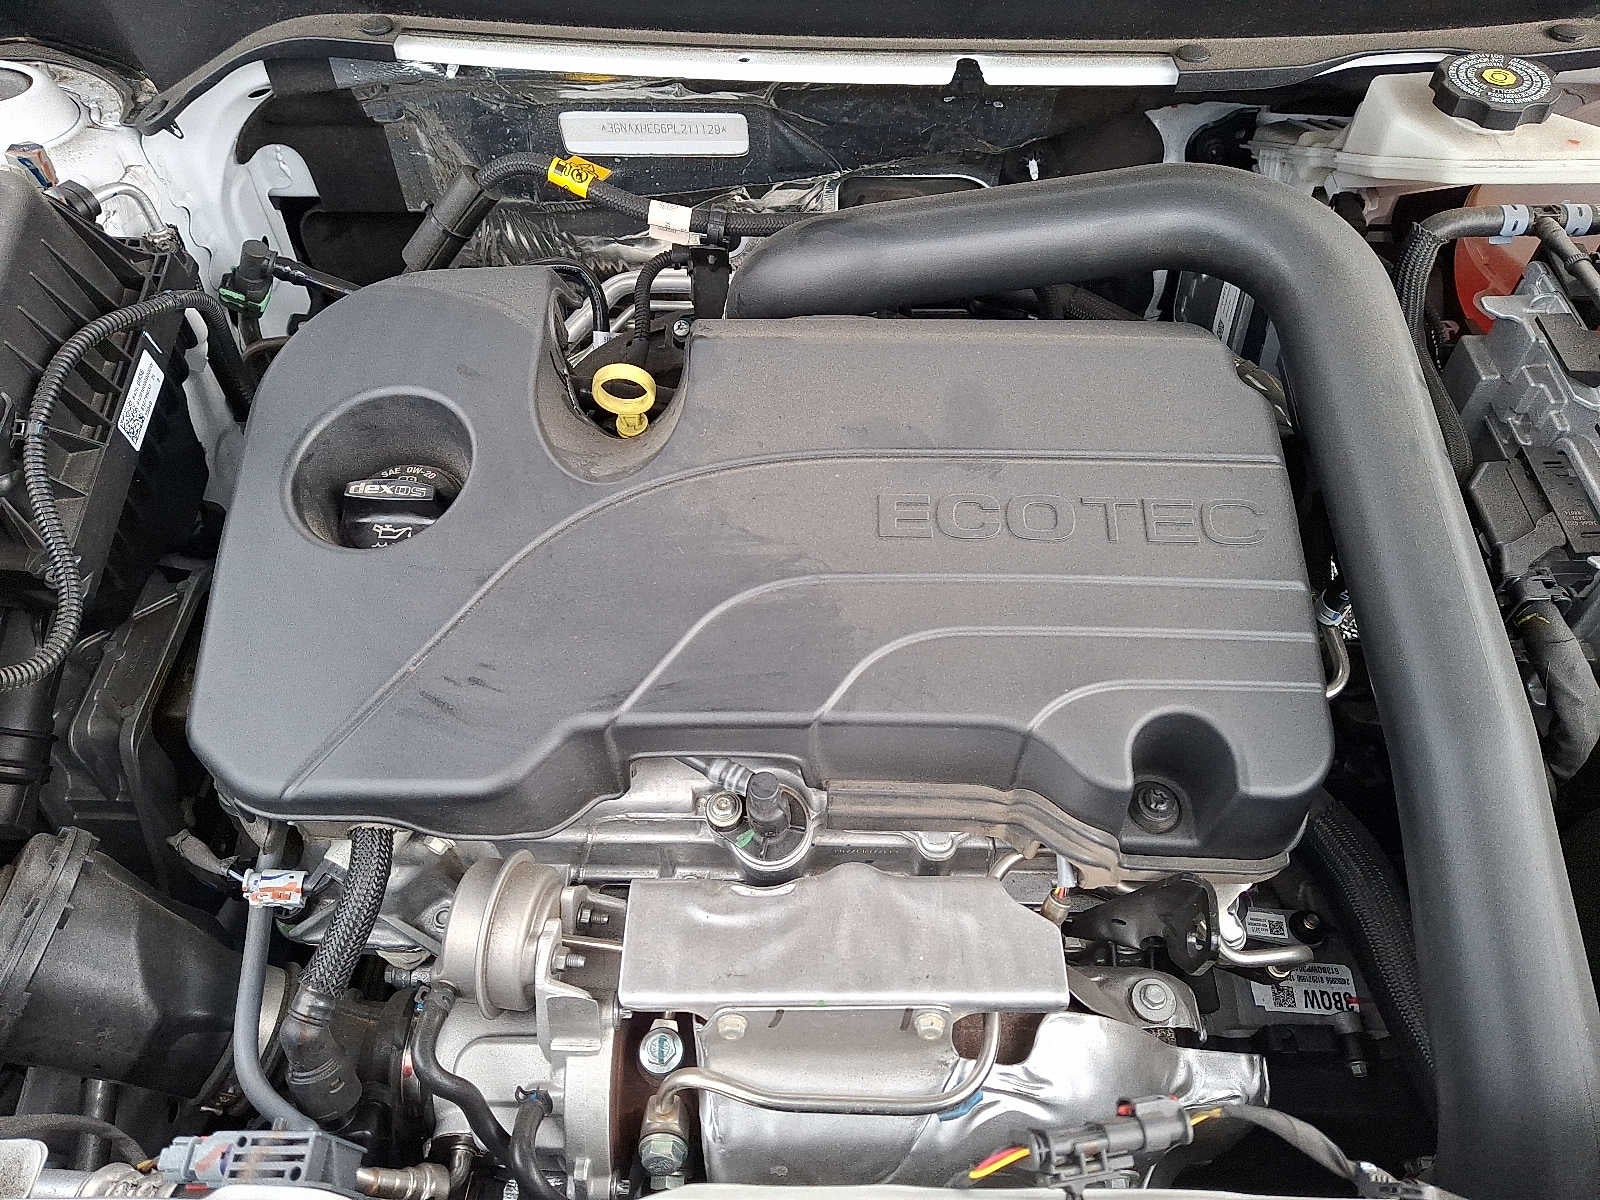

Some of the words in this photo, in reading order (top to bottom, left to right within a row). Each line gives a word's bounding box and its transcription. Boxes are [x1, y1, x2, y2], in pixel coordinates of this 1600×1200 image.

[381, 467, 401, 478] SAE
[406, 466, 437, 480] 0W-20
[348, 482, 427, 497] dexos
[876, 493, 1266, 547] ECOTEC
